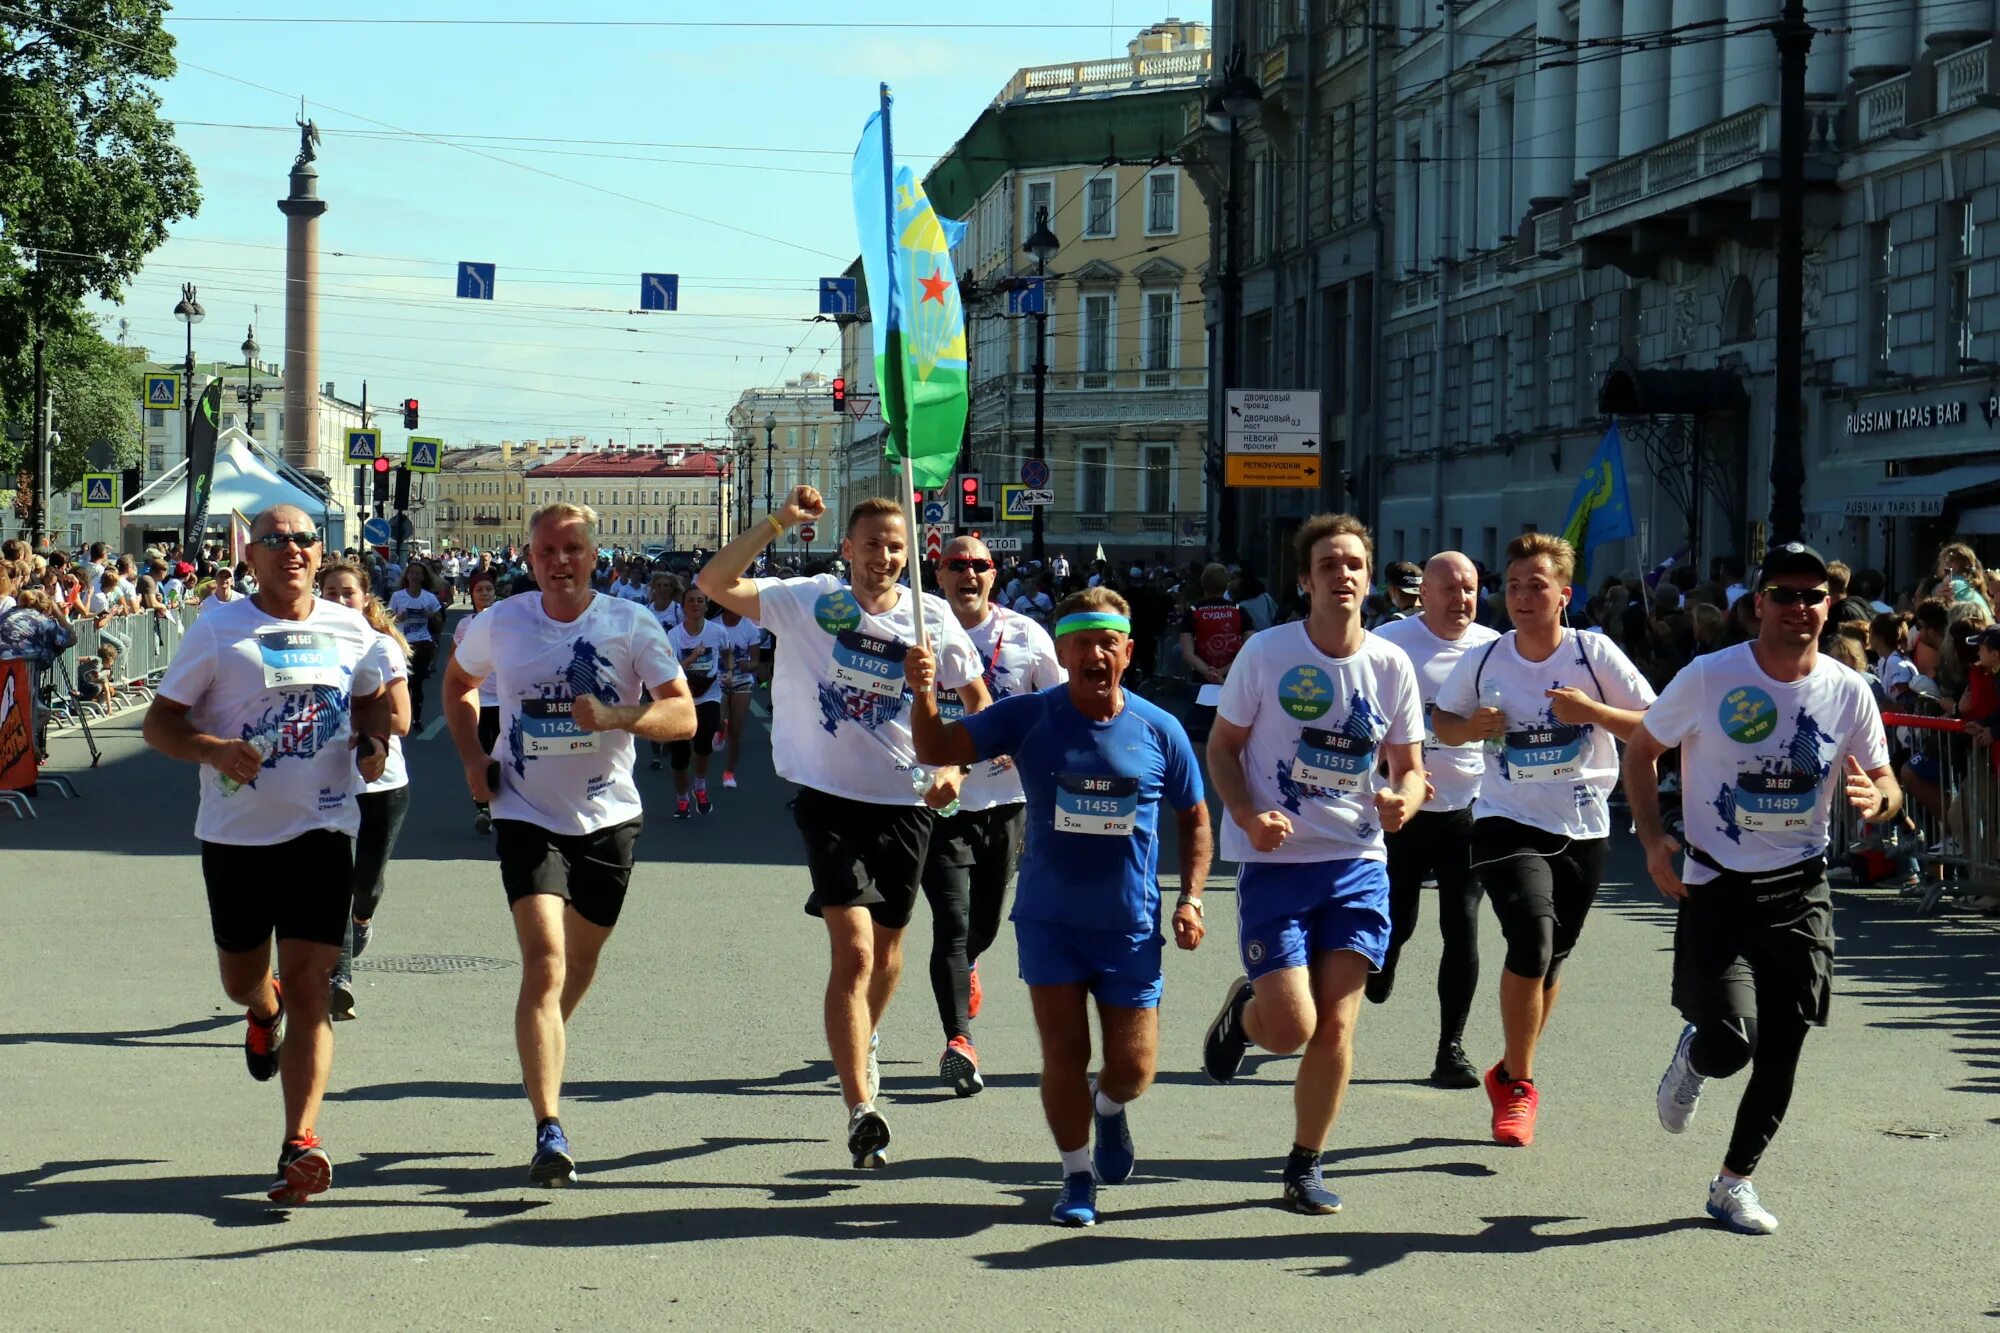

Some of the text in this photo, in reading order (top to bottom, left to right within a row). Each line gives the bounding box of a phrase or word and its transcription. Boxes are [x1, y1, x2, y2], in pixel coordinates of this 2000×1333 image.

[1244, 394, 1290, 403] ДВОРЦОВЫЙ
[1244, 415, 1290, 424] ДВОРЦОВЫЙ
[1846, 401, 1960, 434] RUSSIAN TAPAS BAR
[1243, 434, 1278, 442] НЕВСКИЙ
[1243, 443, 1276, 451] проспект
[1845, 501, 1940, 513] RUSSIAN TAPAS BAR
[986, 539, 1017, 549] СТОП
[1202, 611, 1233, 621] СУДЬЯ
[287, 634, 313, 645] ЗА БЕГ
[860, 637, 887, 654] ЗА БЕГ
[850, 654, 890, 675] 11476
[274, 672, 282, 681] 5
[836, 668, 844, 679] 5
[546, 702, 573, 713] ЗА БЕГ
[937, 706, 964, 718] 1454
[1291, 703, 1319, 714] 90 ЛЕТ
[541, 721, 581, 734] 11424
[1325, 734, 1352, 749] ЗА БЕГ
[1529, 732, 1552, 744] ЗА БЕГ
[532, 741, 539, 751] 5
[1315, 752, 1356, 770] 11515
[1524, 750, 1562, 763] 11427
[1301, 768, 1308, 779] 5
[1517, 770, 1524, 779] 5
[1084, 779, 1112, 791] ЗА БЕГ
[1765, 778, 1793, 789] ЗА БЕГ
[1075, 799, 1119, 813] 11455
[1757, 797, 1799, 810] 11489
[1064, 816, 1071, 827] 5
[1744, 815, 1752, 825] 5
[1113, 822, 1128, 830] ПСБ
